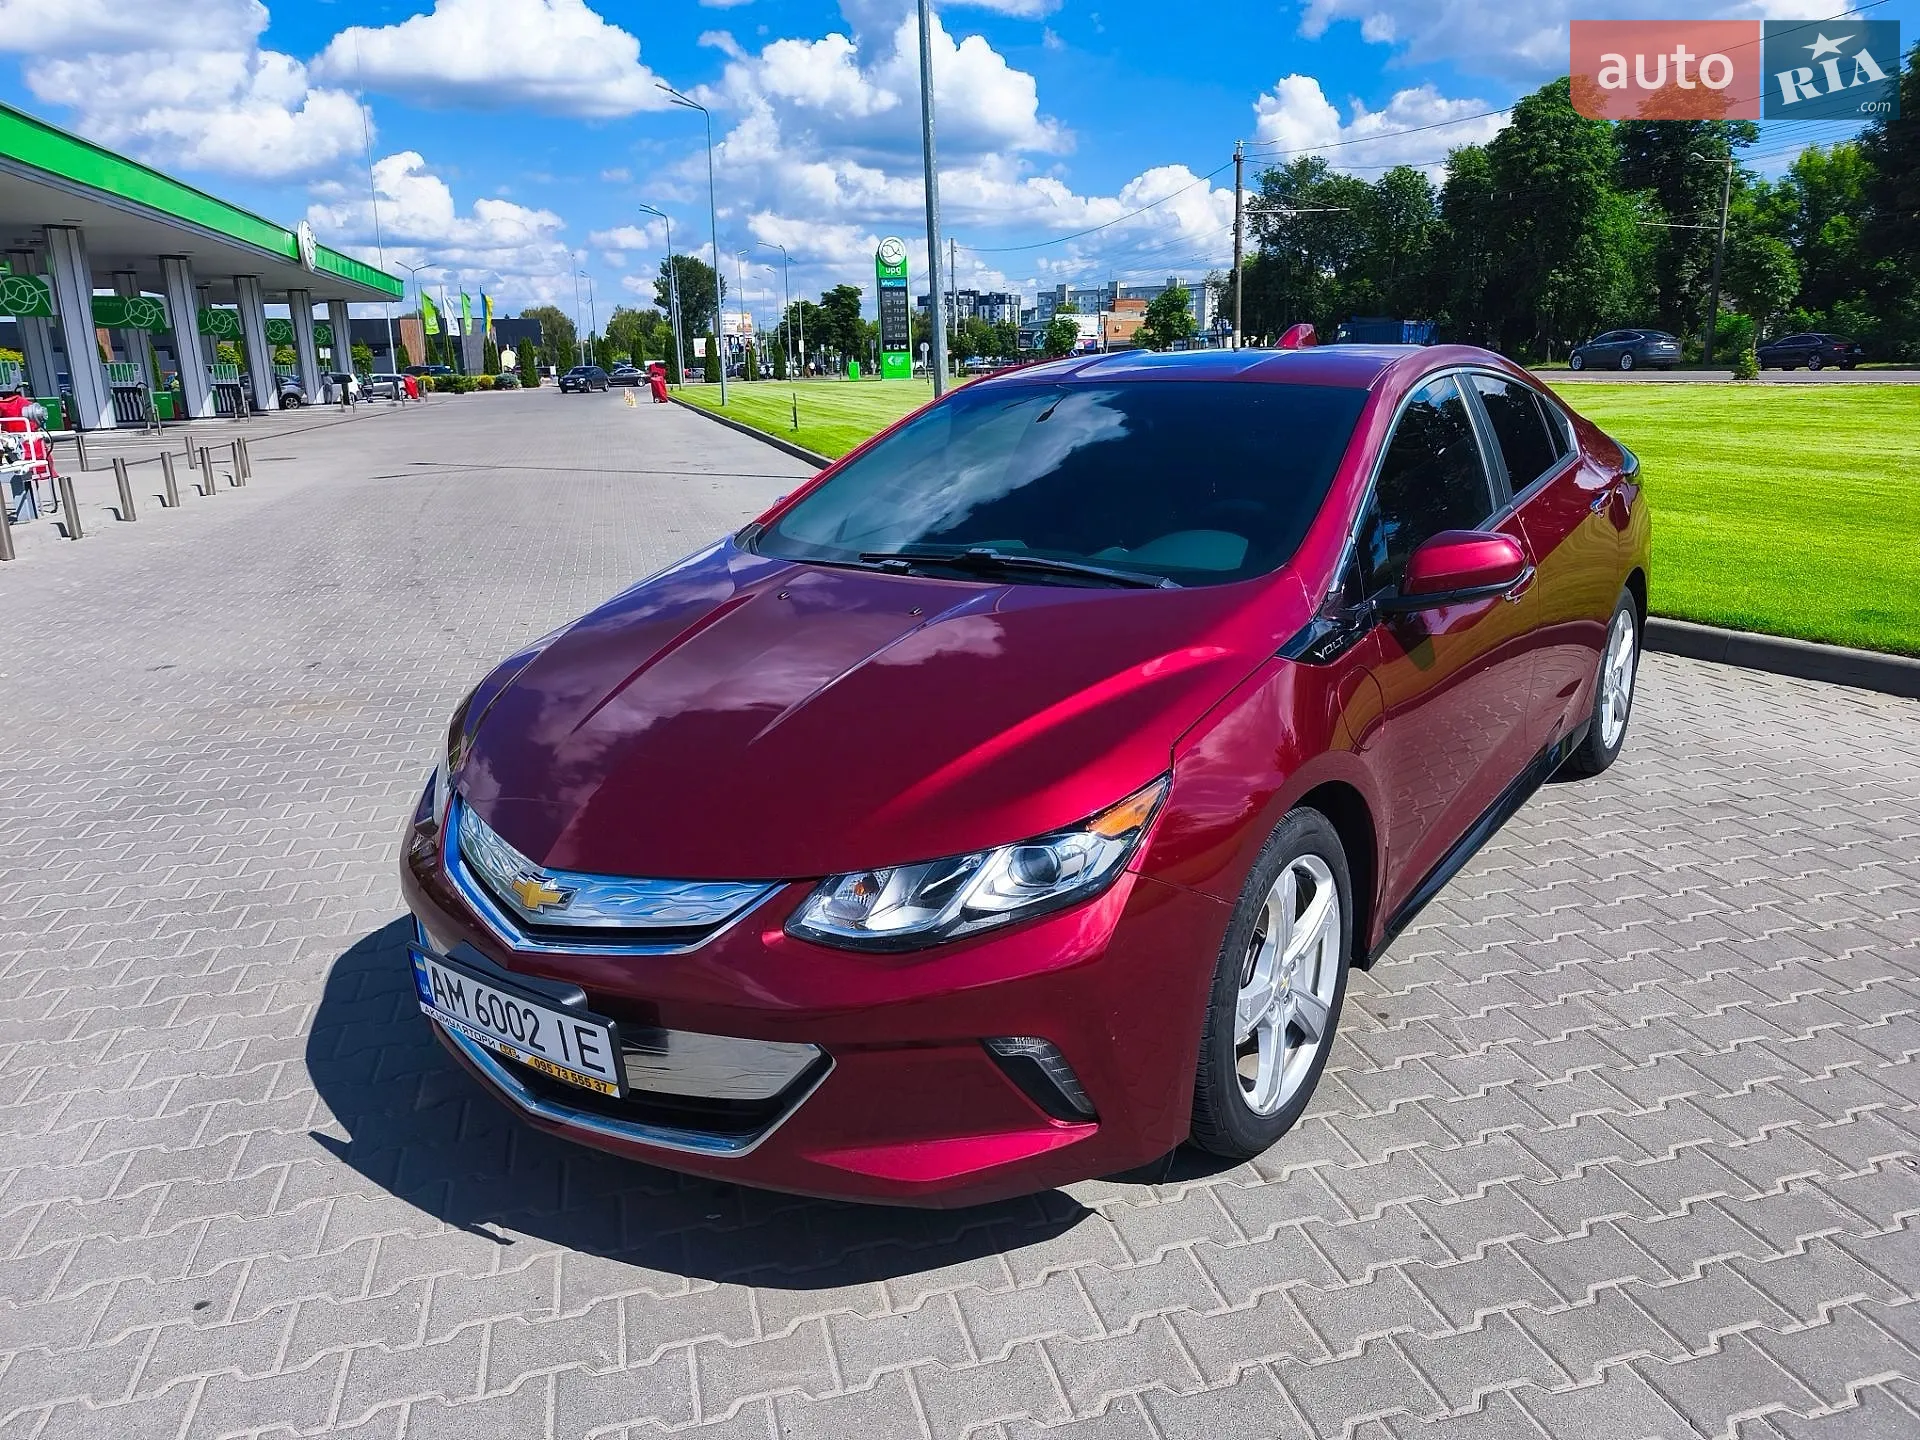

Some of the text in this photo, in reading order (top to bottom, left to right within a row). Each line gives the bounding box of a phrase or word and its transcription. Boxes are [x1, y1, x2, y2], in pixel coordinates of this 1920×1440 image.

[885, 266, 902, 276] upg
[1313, 634, 1344, 660] VOLT
[420, 983, 432, 998] UA
[431, 966, 606, 1074] AM 6002 IE
[534, 1058, 608, 1094] 095 73 555 37
